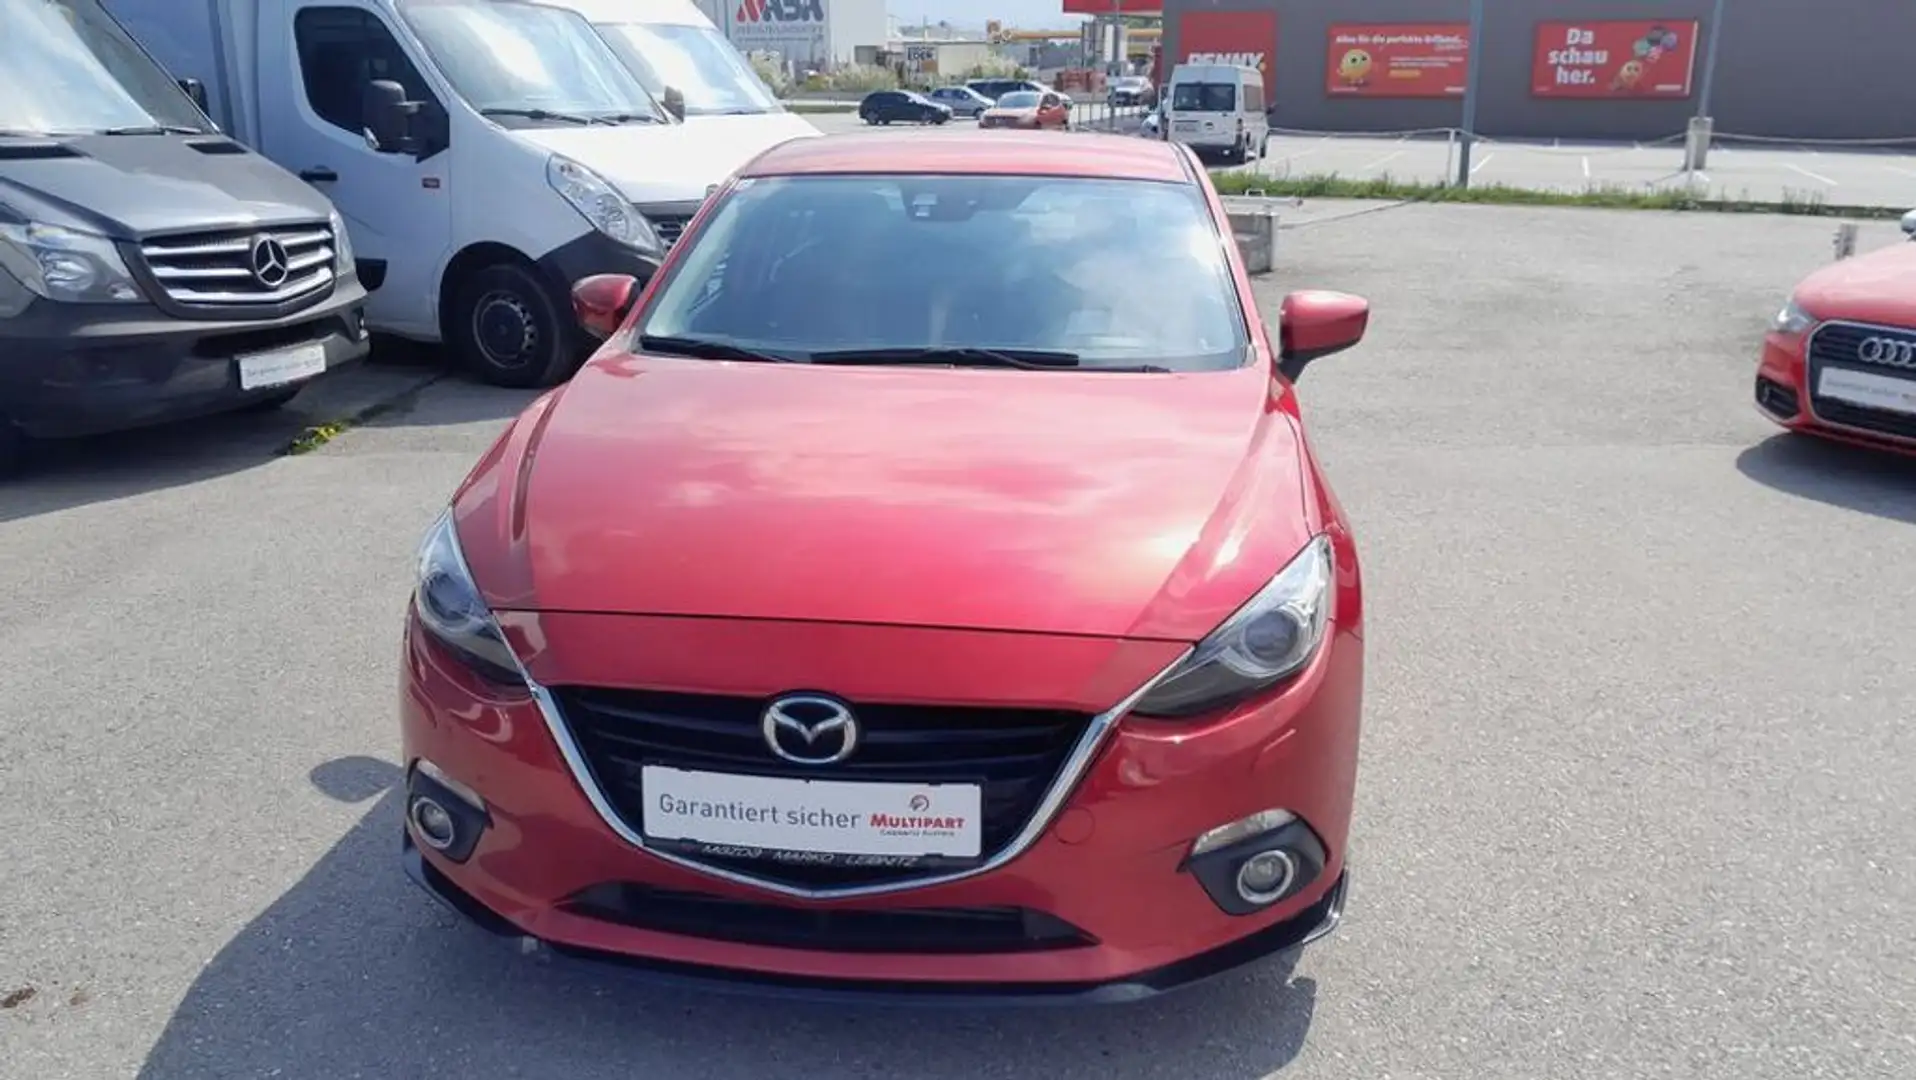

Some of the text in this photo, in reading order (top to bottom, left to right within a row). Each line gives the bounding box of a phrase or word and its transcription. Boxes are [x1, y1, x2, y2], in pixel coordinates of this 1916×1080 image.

[1566, 28, 1594, 45] Da
[1548, 47, 1608, 64] schau
[1556, 66, 1595, 84] her.
[659, 794, 861, 829] Garantiert sicher
[870, 813, 965, 829] MULTIPART
